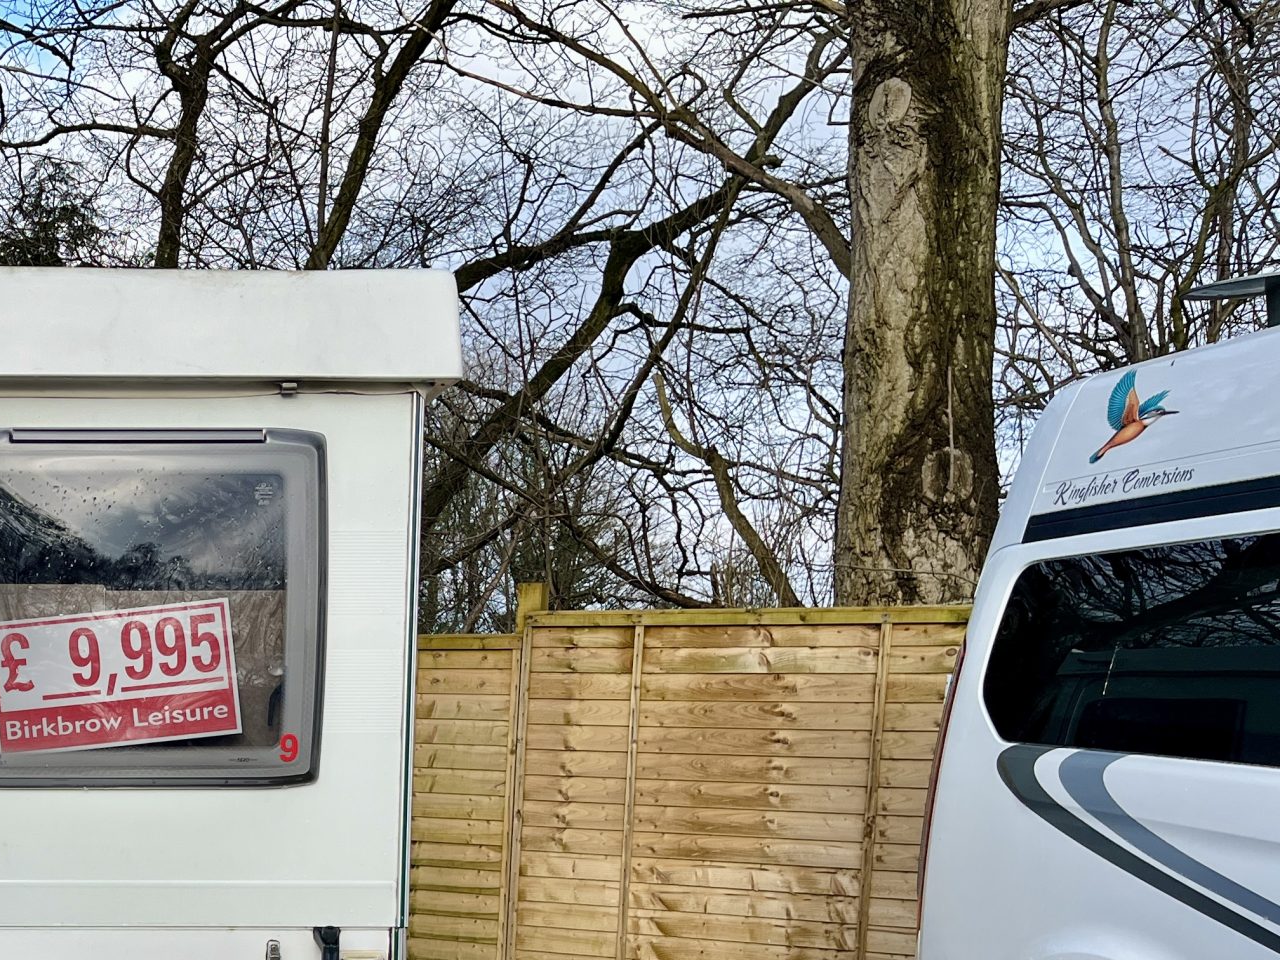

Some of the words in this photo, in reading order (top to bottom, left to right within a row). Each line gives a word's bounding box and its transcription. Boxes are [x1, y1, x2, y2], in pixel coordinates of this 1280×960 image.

[1053, 473, 1118, 506] Kingfisher
[1123, 467, 1195, 493] Conversions
[0, 632, 35, 693] £
[68, 612, 221, 696] 9,995
[5, 715, 122, 741] Birkbrow
[132, 704, 229, 727] Leisure
[279, 733, 299, 763] 9
